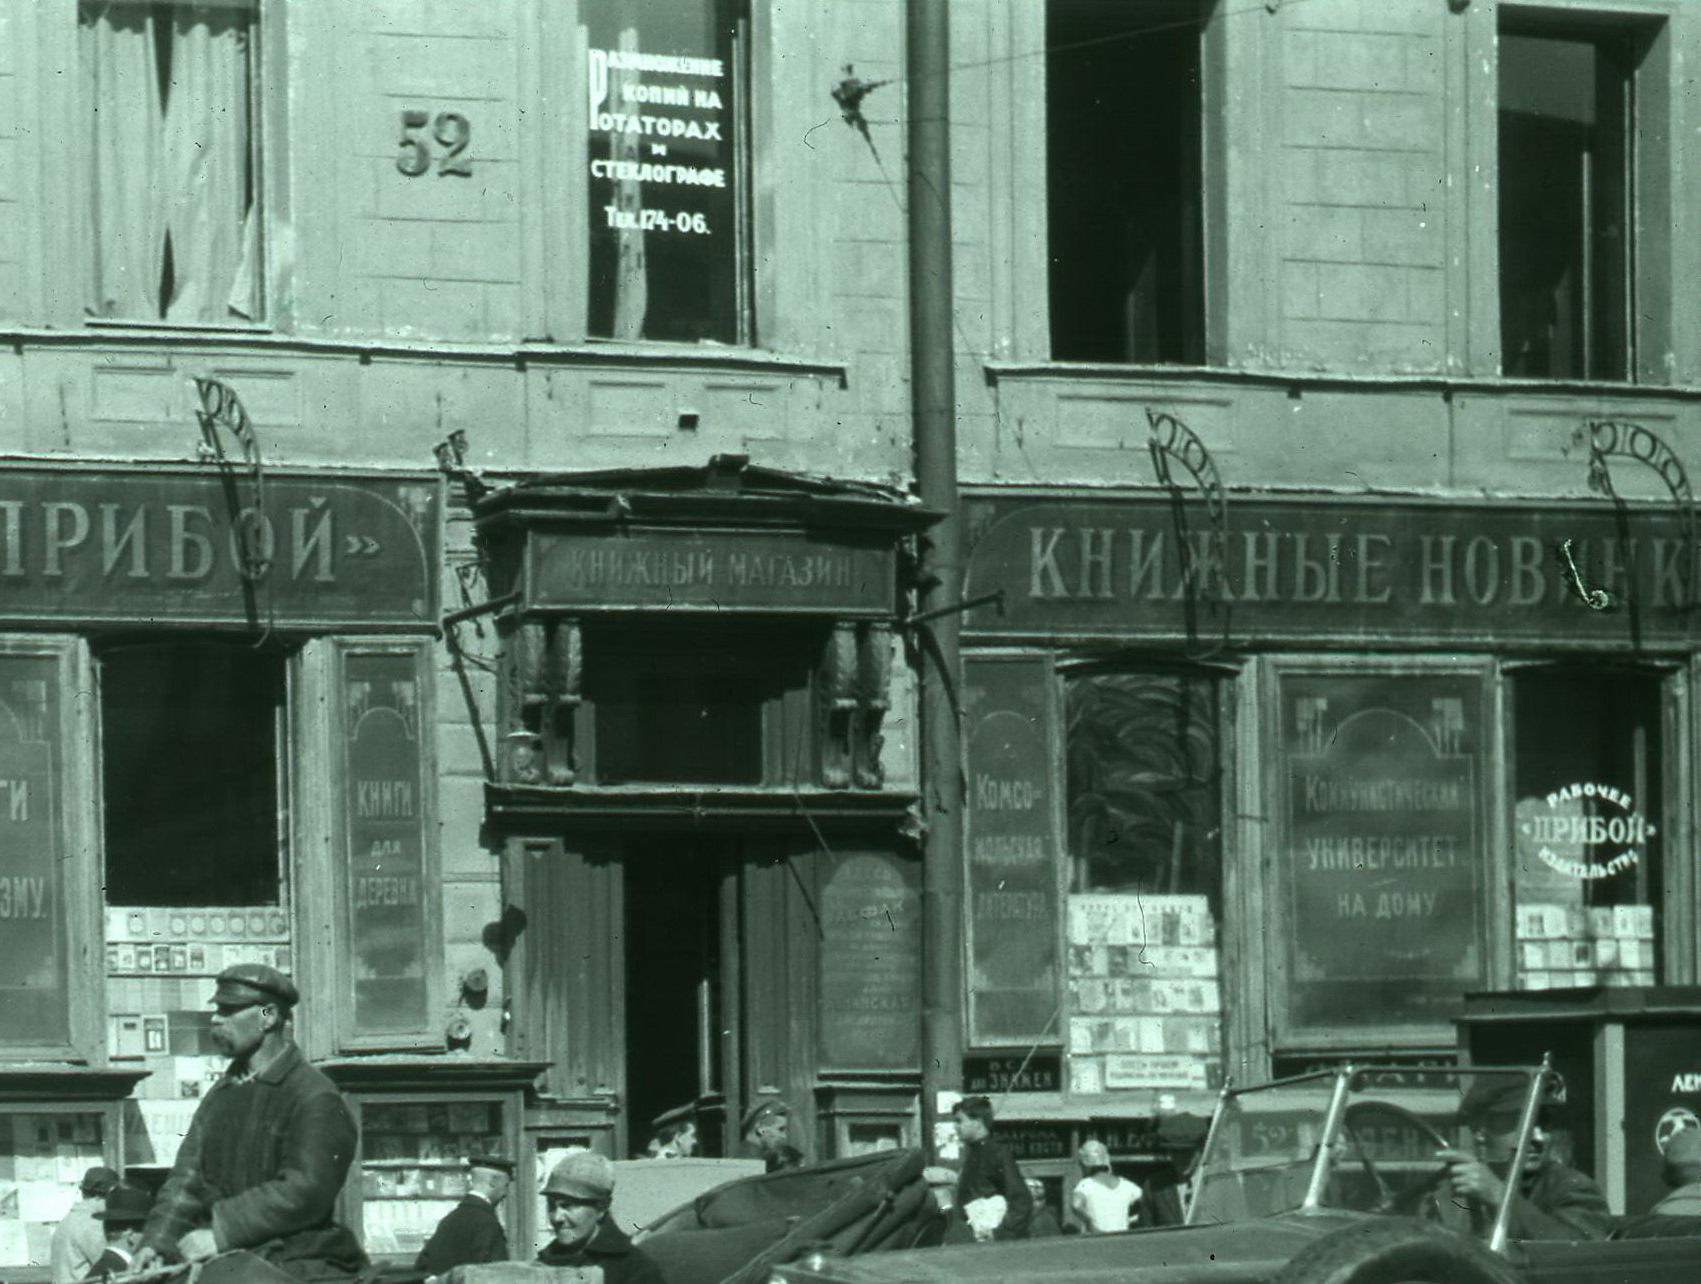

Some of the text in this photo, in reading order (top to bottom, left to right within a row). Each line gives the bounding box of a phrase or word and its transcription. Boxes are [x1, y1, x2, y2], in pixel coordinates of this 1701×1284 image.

[623, 84, 722, 109] КОПИЙ НА
[396, 109, 473, 178] 52
[591, 160, 725, 188] СТЕКЛОГРАФЕ
[570, 549, 851, 587] КНИЖНЫЙ МАГАЗИН
[1030, 527, 1701, 607] КНИЖНЫЕ НОВИНК
[1546, 783, 1632, 809] РАБОЧЕЕ
[1305, 836, 1457, 870] УНИВЕРСИТЕТ
[1338, 886, 1439, 920] НА ДОМУ
